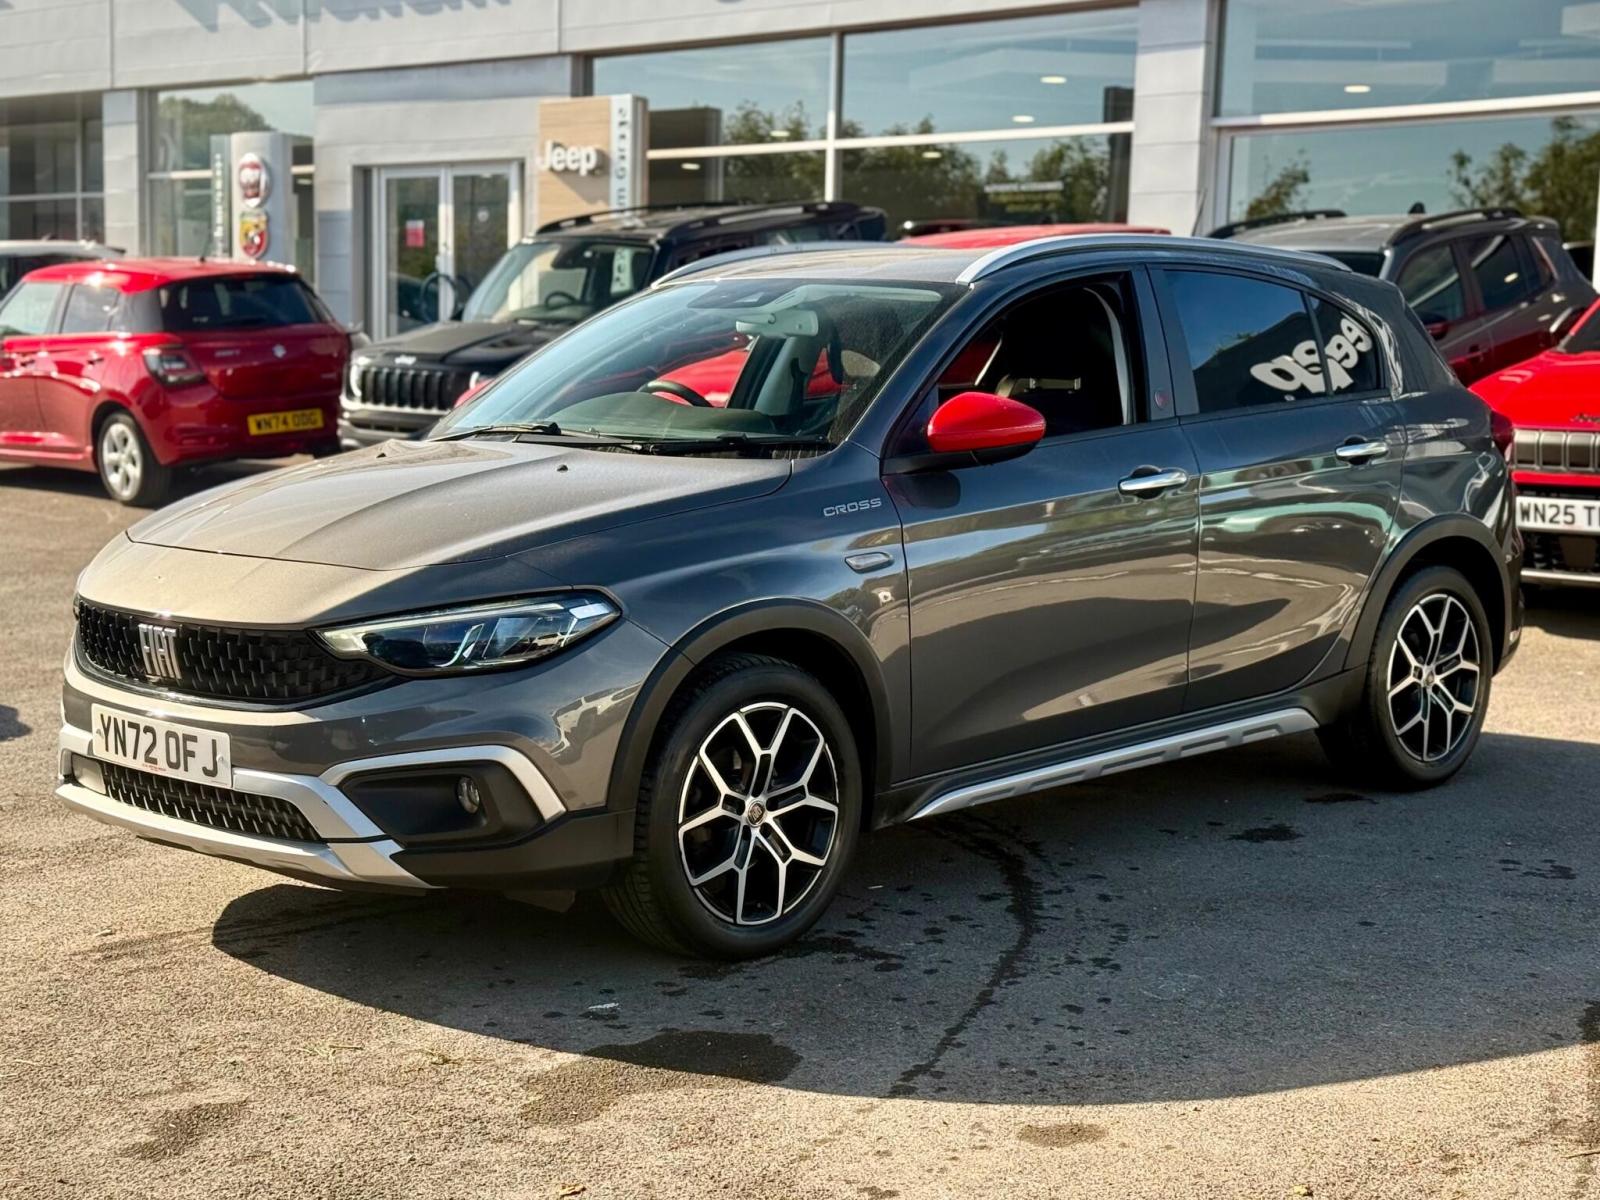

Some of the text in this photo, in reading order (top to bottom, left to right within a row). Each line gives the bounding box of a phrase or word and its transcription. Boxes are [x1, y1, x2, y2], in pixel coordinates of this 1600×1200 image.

[537, 139, 597, 176] Jeep
[823, 498, 882, 517] CROSS
[1520, 502, 1600, 527] WN25 T
[138, 623, 182, 680] FIAT
[100, 713, 219, 778] YN72 OFJ
